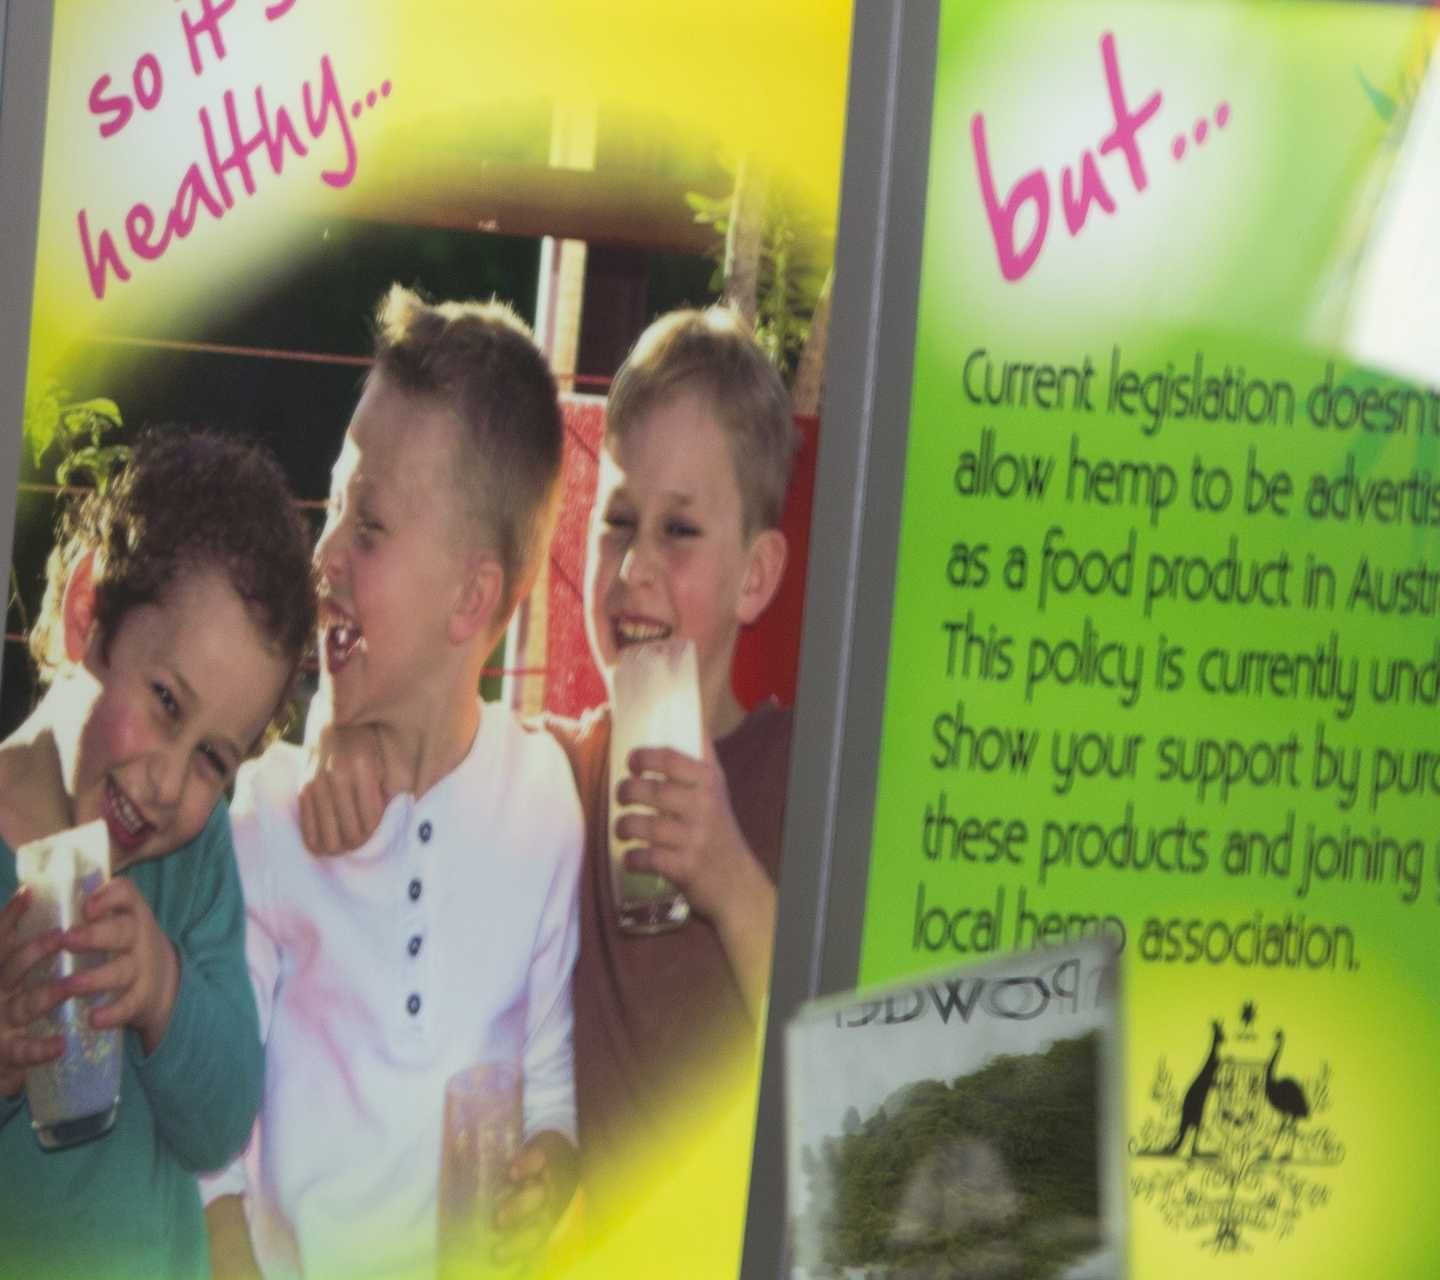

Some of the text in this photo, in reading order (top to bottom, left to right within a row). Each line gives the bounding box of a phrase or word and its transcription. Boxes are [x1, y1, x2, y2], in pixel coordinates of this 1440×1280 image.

[87, 53, 163, 139] so
[77, 54, 393, 300] healthy...
[970, 30, 1231, 283] but...
[962, 349, 1094, 413] Current
[1108, 344, 1295, 437] legislation
[954, 426, 1054, 502] allow
[1066, 432, 1177, 525] hemp
[1191, 449, 1232, 513] to
[1243, 445, 1293, 516] be
[945, 539, 989, 591] as
[1003, 543, 1027, 591] a
[1037, 525, 1136, 613] food
[1145, 535, 1290, 619] product
[1302, 553, 1337, 610] in
[943, 617, 1014, 683] This
[1025, 615, 1144, 709] policy
[1155, 632, 1185, 693] is
[1197, 629, 1358, 720] currently
[930, 700, 1039, 775] Show
[1051, 726, 1145, 795] your
[1157, 729, 1302, 805] support
[1313, 722, 1361, 811] by
[922, 792, 1029, 865] these
[1040, 802, 1210, 884] products
[1224, 810, 1295, 880] and
[1298, 820, 1424, 905] joining
[912, 881, 1360, 972] local hemp association.
